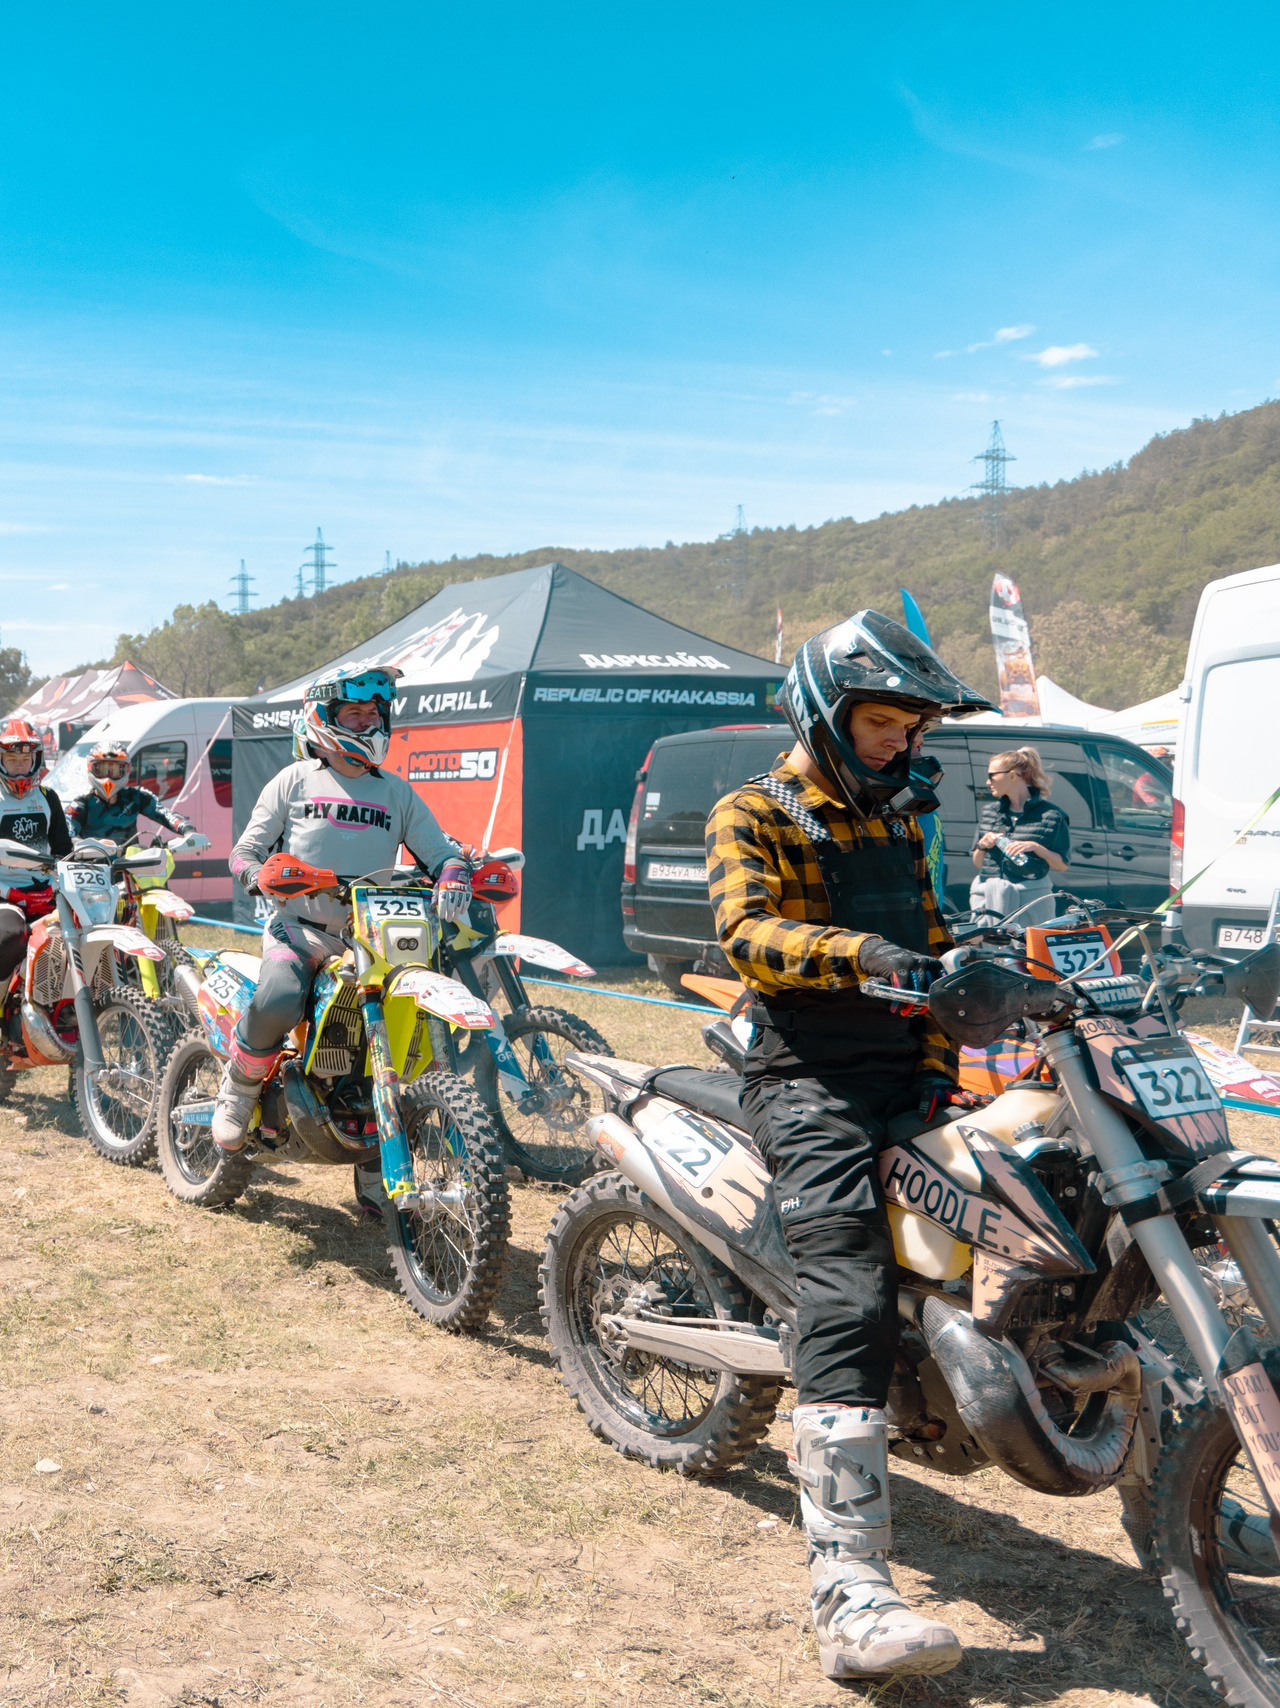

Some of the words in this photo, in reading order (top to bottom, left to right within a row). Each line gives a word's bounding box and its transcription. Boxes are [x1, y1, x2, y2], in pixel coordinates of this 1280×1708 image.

[579, 651, 731, 670] ДАРКСАЙД
[306, 686, 334, 699] LEATT
[418, 690, 493, 713] KIRILL
[534, 688, 624, 702] REPUBLIC
[625, 689, 650, 703] OF
[652, 690, 756, 706] KHAKASSIA
[433, 771, 460, 779] SHOP
[304, 803, 332, 819] FLY
[73, 872, 105, 885] 326
[374, 900, 421, 916] 325
[1056, 948, 1105, 974] 323
[207, 974, 236, 1000] 325
[1080, 975, 1141, 991] ENTHAL
[1093, 984, 1146, 1004] ENTHAL
[1137, 1066, 1213, 1107] 322
[653, 1135, 712, 1178] 22
[1238, 1403, 1266, 1425] BUT
